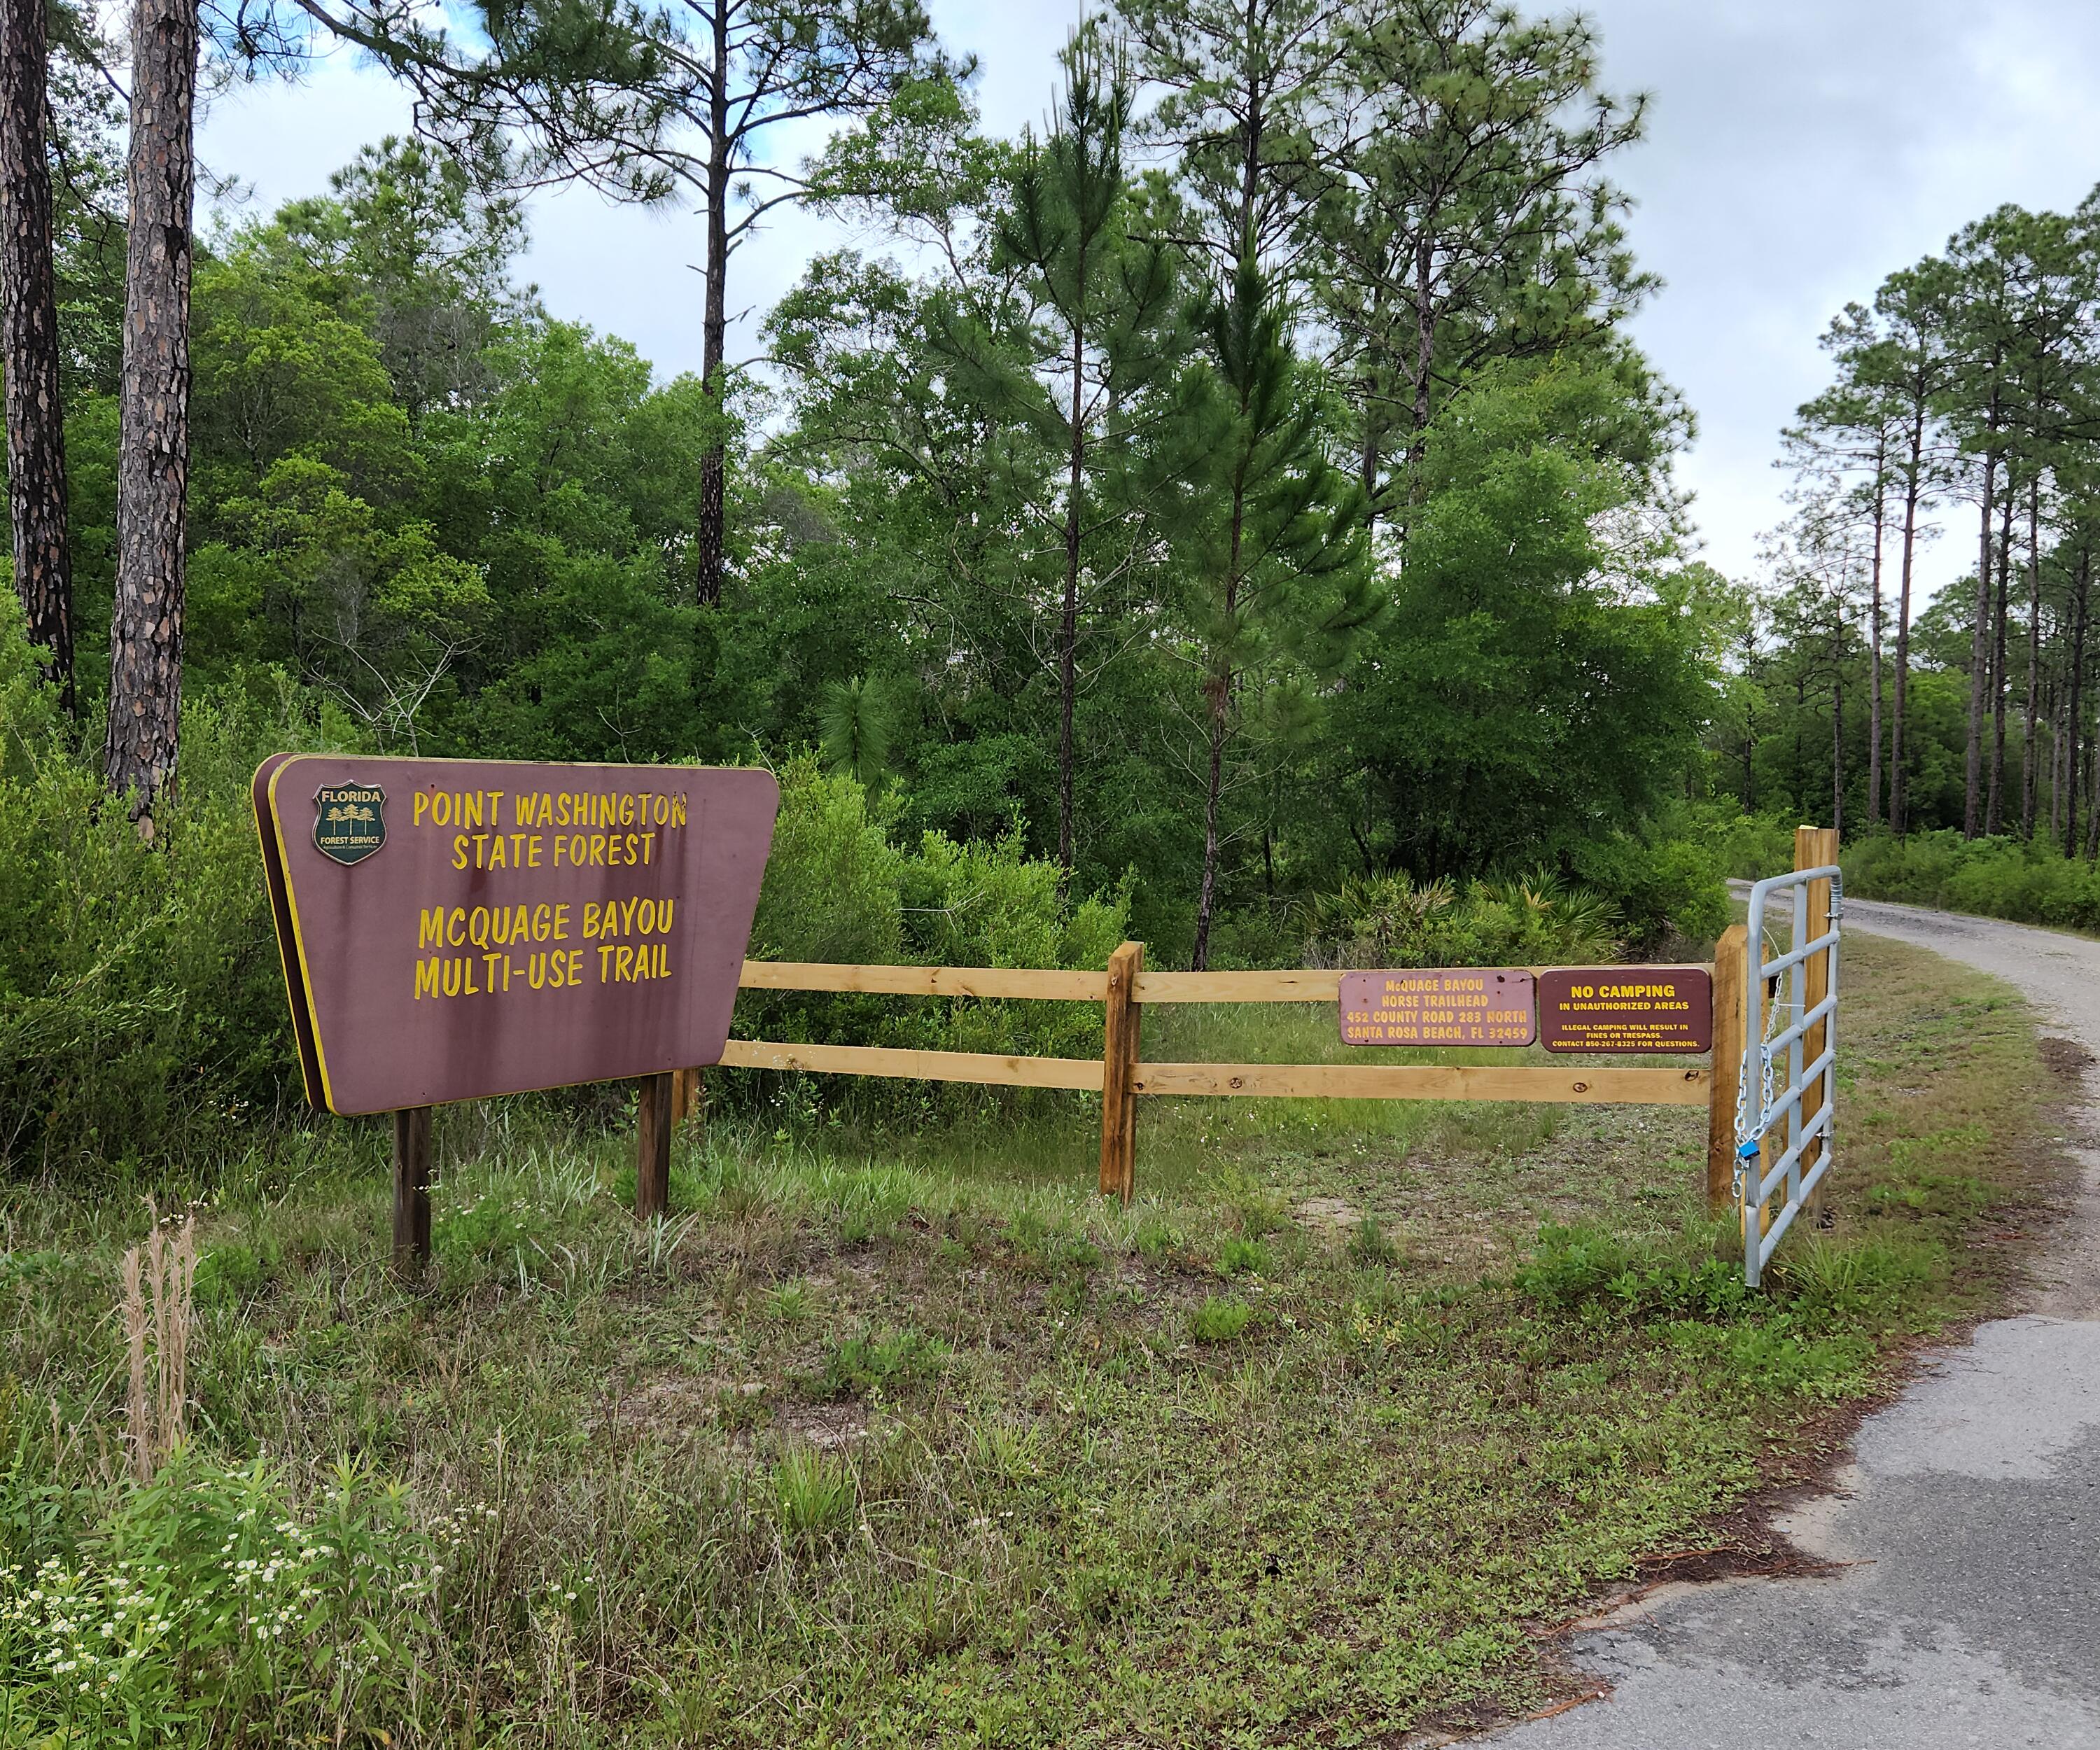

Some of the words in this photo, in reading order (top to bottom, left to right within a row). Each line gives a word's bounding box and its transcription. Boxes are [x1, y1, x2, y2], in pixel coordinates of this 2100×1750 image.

[322, 791, 381, 802] FLORIDA
[413, 790, 505, 830] POINT
[515, 791, 687, 829] WASHINGTON
[350, 836, 379, 844] SERVICE
[451, 833, 544, 871] STATE
[554, 832, 656, 867] FOREST
[419, 903, 570, 951] MCQUAGE
[582, 896, 674, 939] BAYOU
[414, 948, 584, 1000] MULTI-USE
[597, 943, 673, 983] TRAIL
[1385, 979, 1439, 992] McQUAGE
[1444, 979, 1484, 992] BAYOU
[1571, 986, 1594, 998] NO
[1599, 985, 1675, 997] CAMPING
[1382, 995, 1419, 1007] HORSE
[1423, 995, 1489, 1007] TRAILHEAD
[1559, 1002, 1570, 1011] IN
[1573, 1002, 1651, 1011] UNAUTHORIZED
[1654, 1002, 1689, 1010] AREAS
[1346, 1011, 1368, 1023] 452
[1373, 1011, 1418, 1023] COUNTY
[1422, 1011, 1455, 1023] ROAD
[1458, 1011, 1481, 1023] 283
[1486, 1010, 1527, 1023] NORTH
[1347, 1026, 1383, 1039] SANTA
[1387, 1026, 1418, 1039] ROSA
[1422, 1026, 1465, 1040] BEACH,
[1471, 1026, 1484, 1039] FL
[1489, 1027, 1527, 1040] 32459
